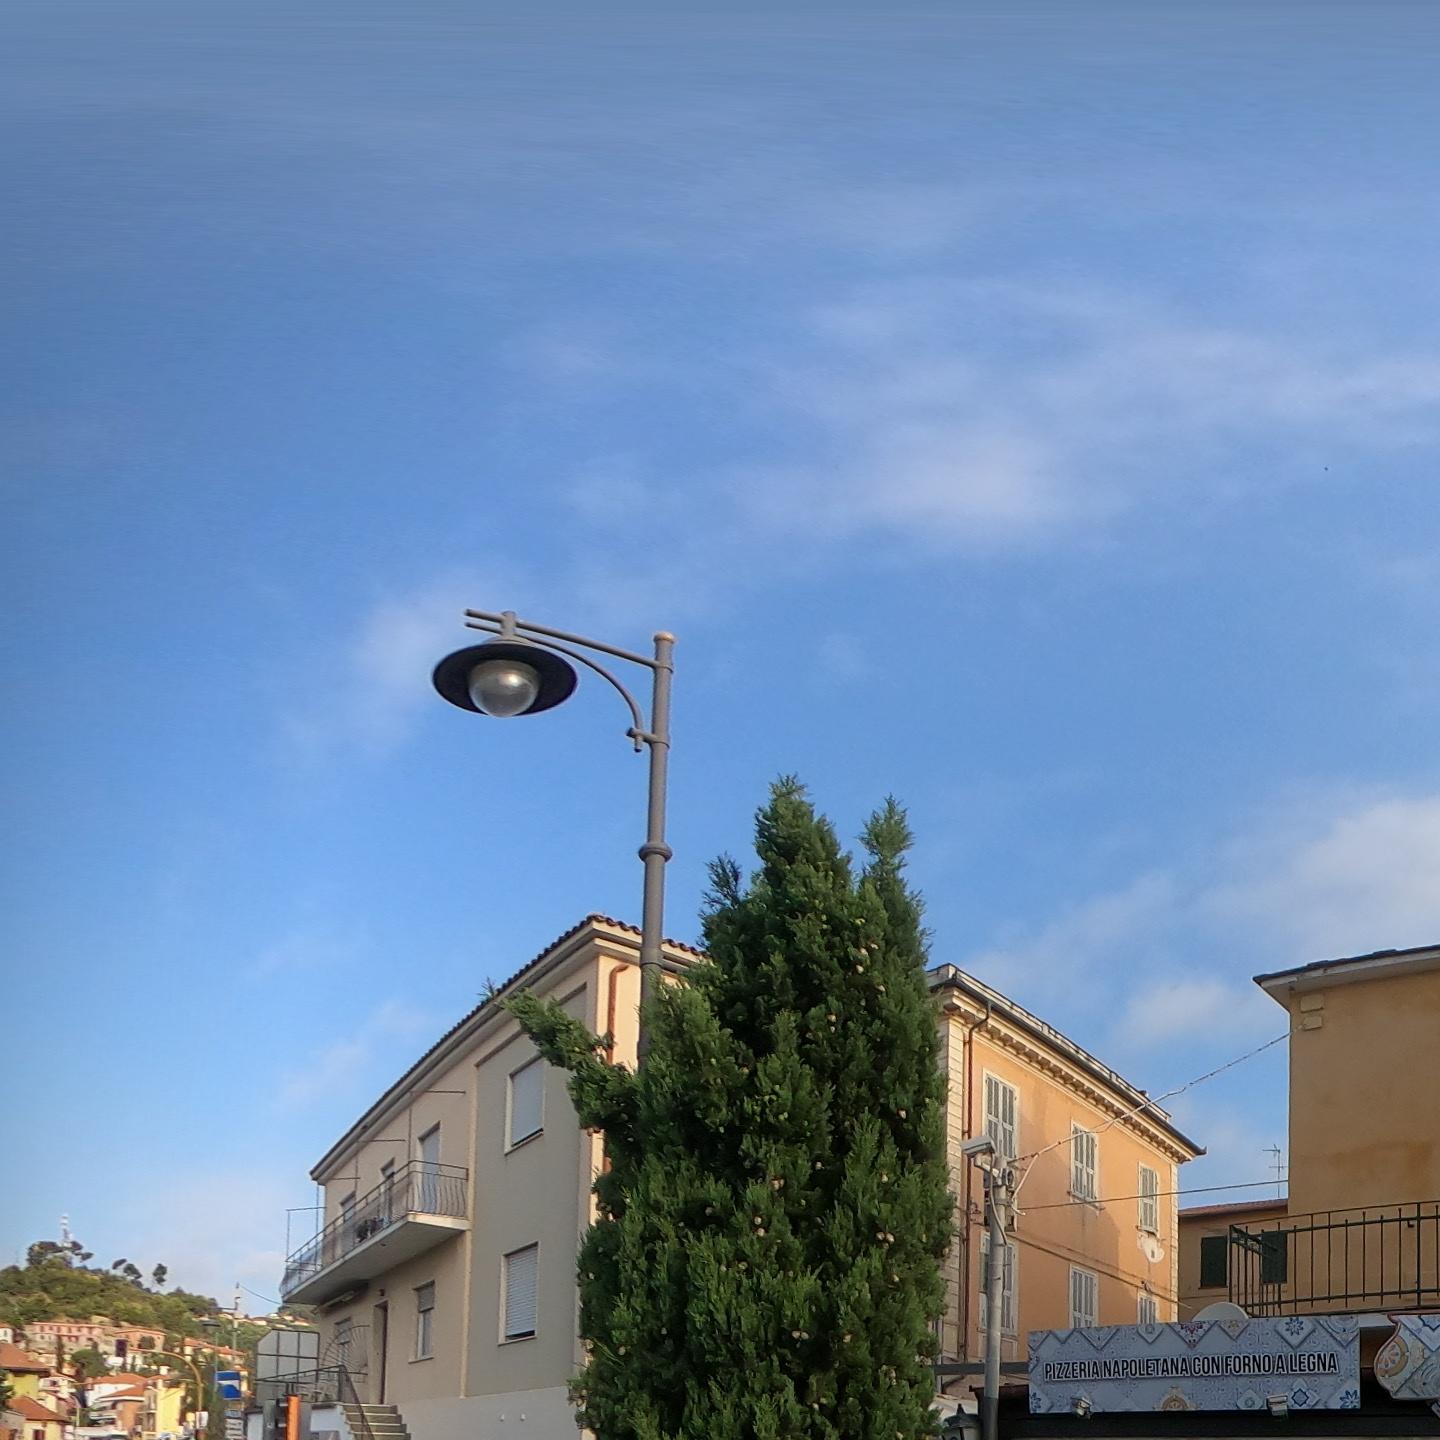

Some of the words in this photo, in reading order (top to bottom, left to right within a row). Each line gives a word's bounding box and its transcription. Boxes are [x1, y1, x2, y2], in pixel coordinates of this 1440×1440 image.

[1044, 1359, 1099, 1381] PIZZERIA
[1102, 1356, 1189, 1379] NAPOLETANA
[1193, 1355, 1222, 1377] CON
[1224, 1354, 1272, 1376] FORNO
[1275, 1354, 1286, 1374] A
[1289, 1352, 1339, 1374] LEGNA
